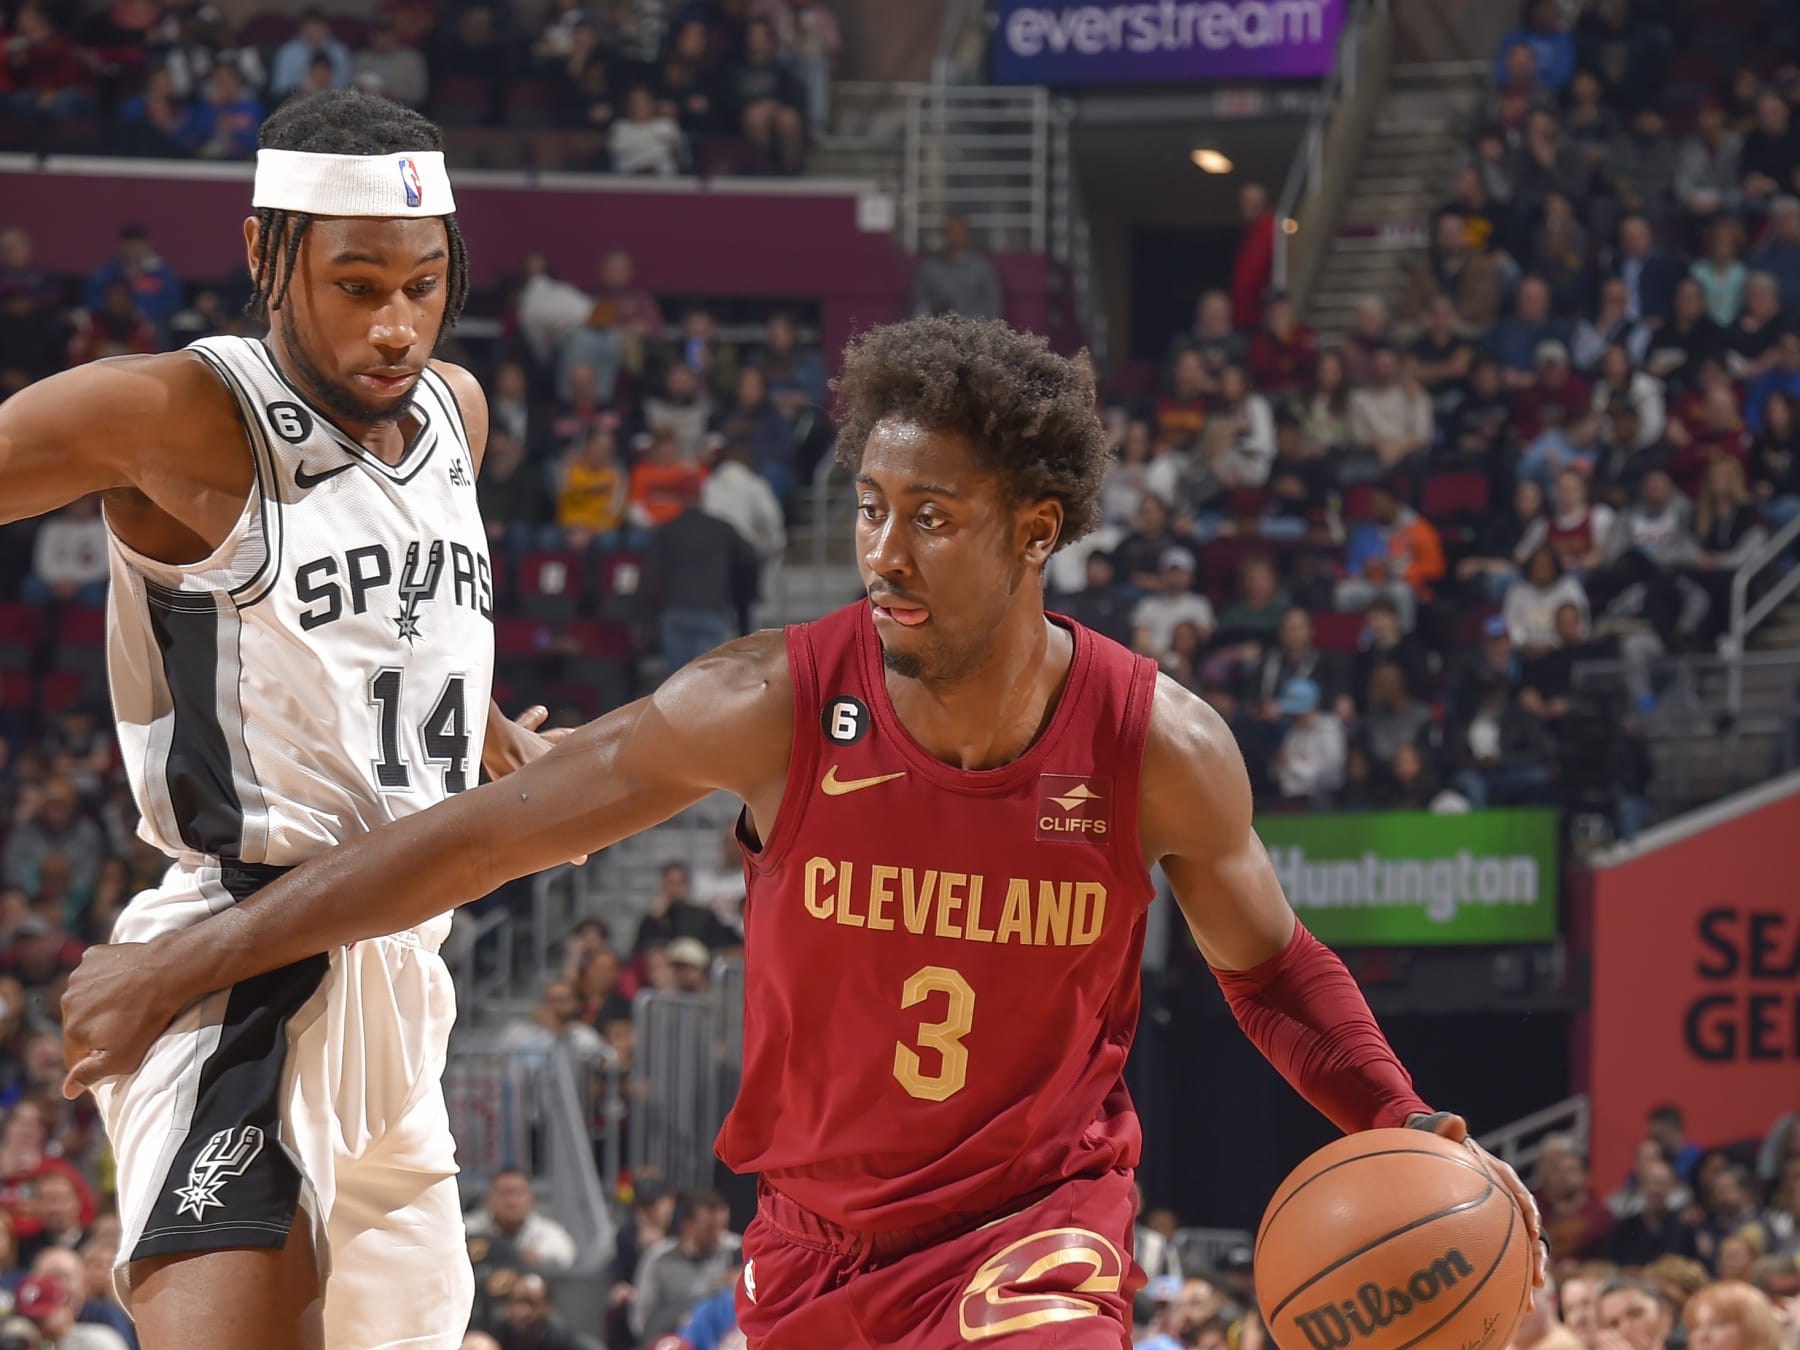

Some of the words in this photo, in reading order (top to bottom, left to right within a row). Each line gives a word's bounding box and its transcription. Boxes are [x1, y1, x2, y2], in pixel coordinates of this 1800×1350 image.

[1005, 0, 1325, 56] everstream
[274, 407, 304, 438] 6
[295, 539, 494, 641] SPURS
[368, 666, 473, 796] 14
[831, 702, 858, 740] 6
[1039, 816, 1107, 834] CLIFFS
[804, 856, 1107, 946] CLEVELAND
[1268, 845, 1539, 923] Huntington
[1695, 908, 1800, 980] SE
[893, 965, 976, 1102] 3
[1683, 993, 1800, 1062] GE
